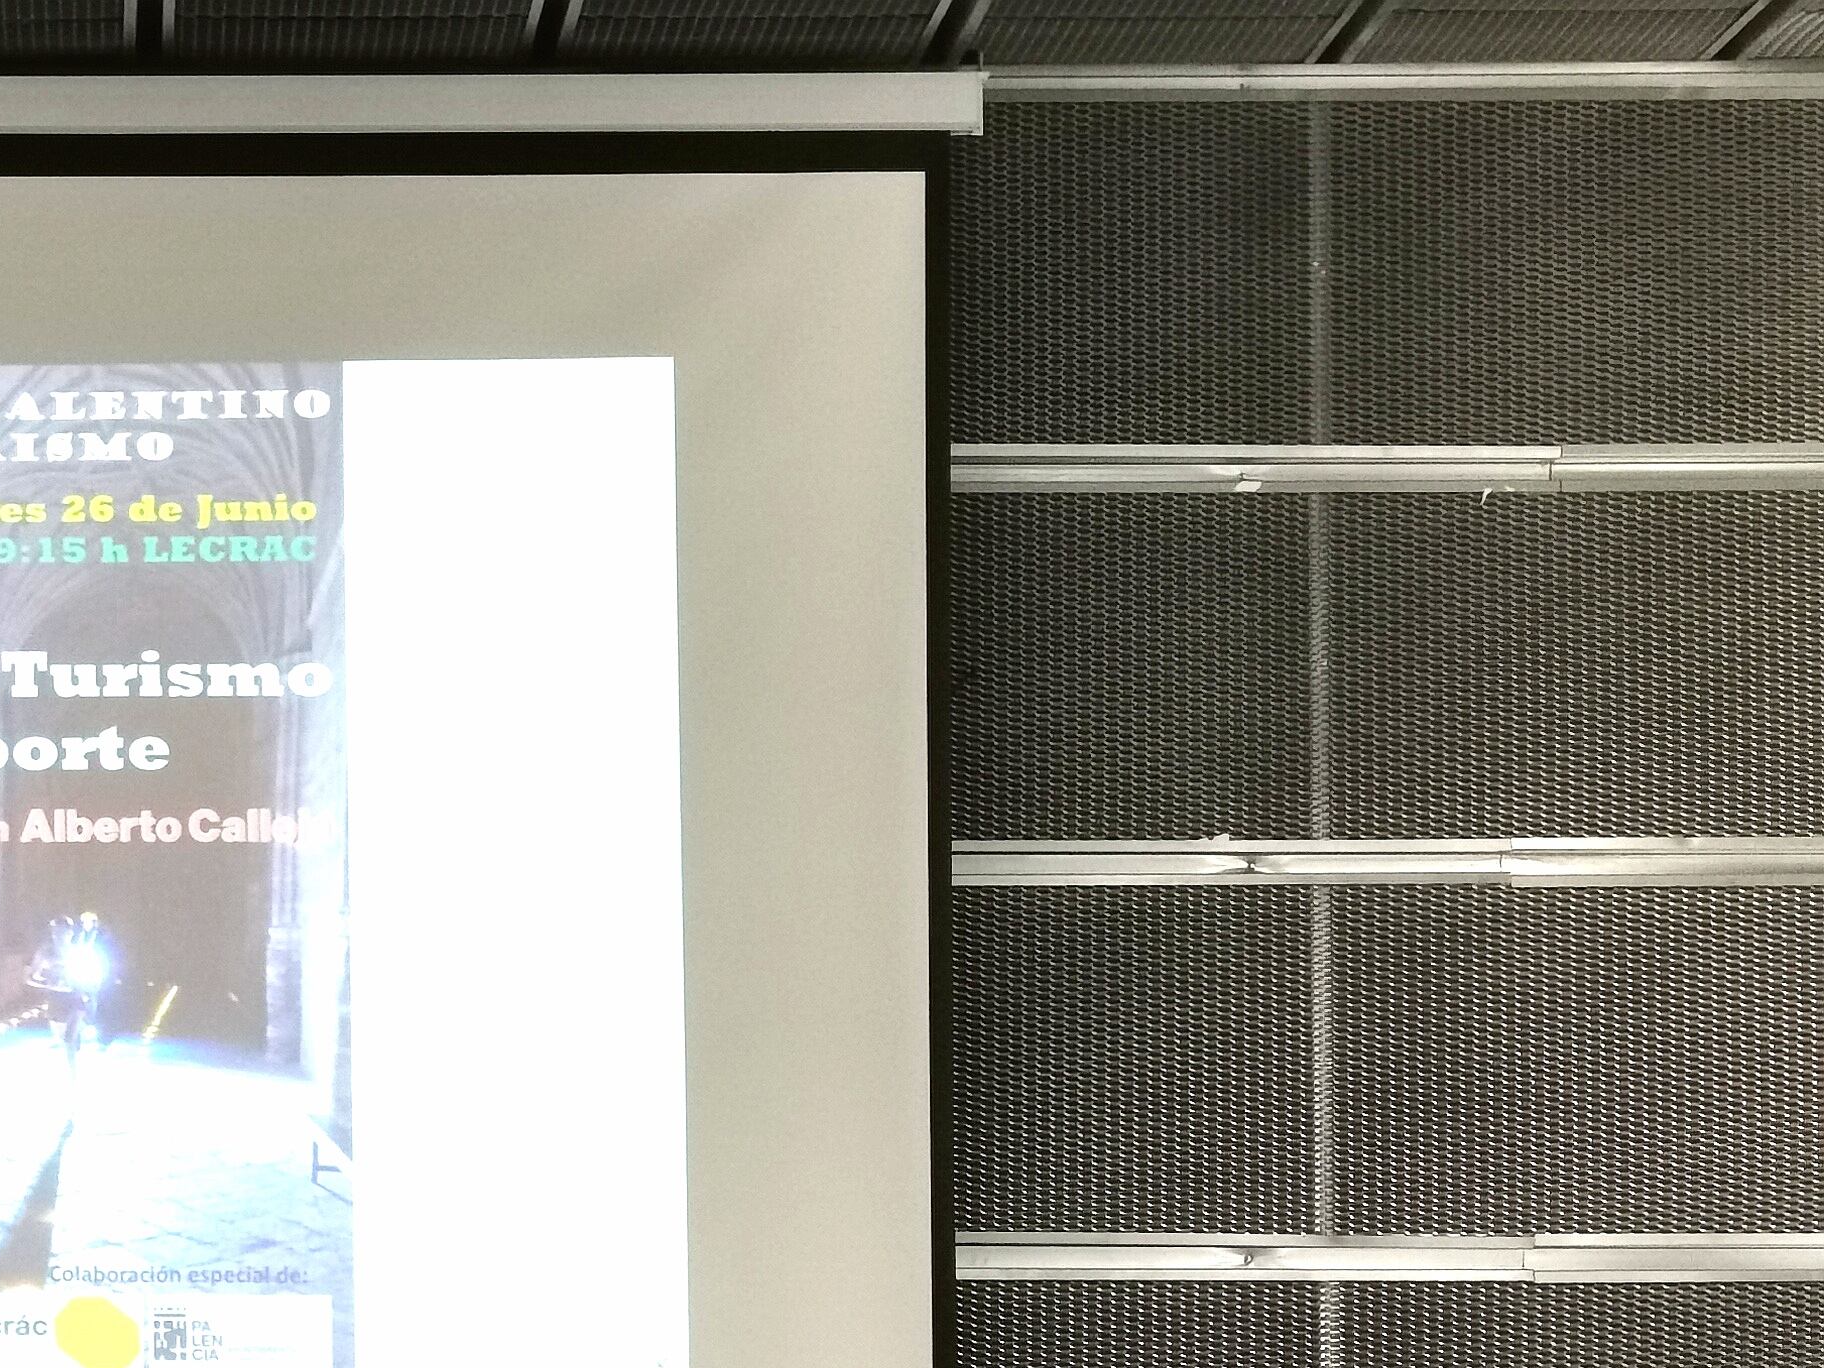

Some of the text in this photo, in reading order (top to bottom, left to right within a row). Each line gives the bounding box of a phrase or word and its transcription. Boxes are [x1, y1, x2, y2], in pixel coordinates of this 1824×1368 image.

[61, 495, 115, 523] 26
[128, 495, 183, 522] de
[196, 494, 317, 530] Junio
[100, 536, 129, 563] h
[143, 535, 318, 563] LECRAC
[1, 650, 332, 699] Turismo
[20, 808, 182, 843] Alberto
[188, 808, 338, 847] Callej
[50, 1266, 181, 1283] Colaboración
[188, 1266, 270, 1285] especial
